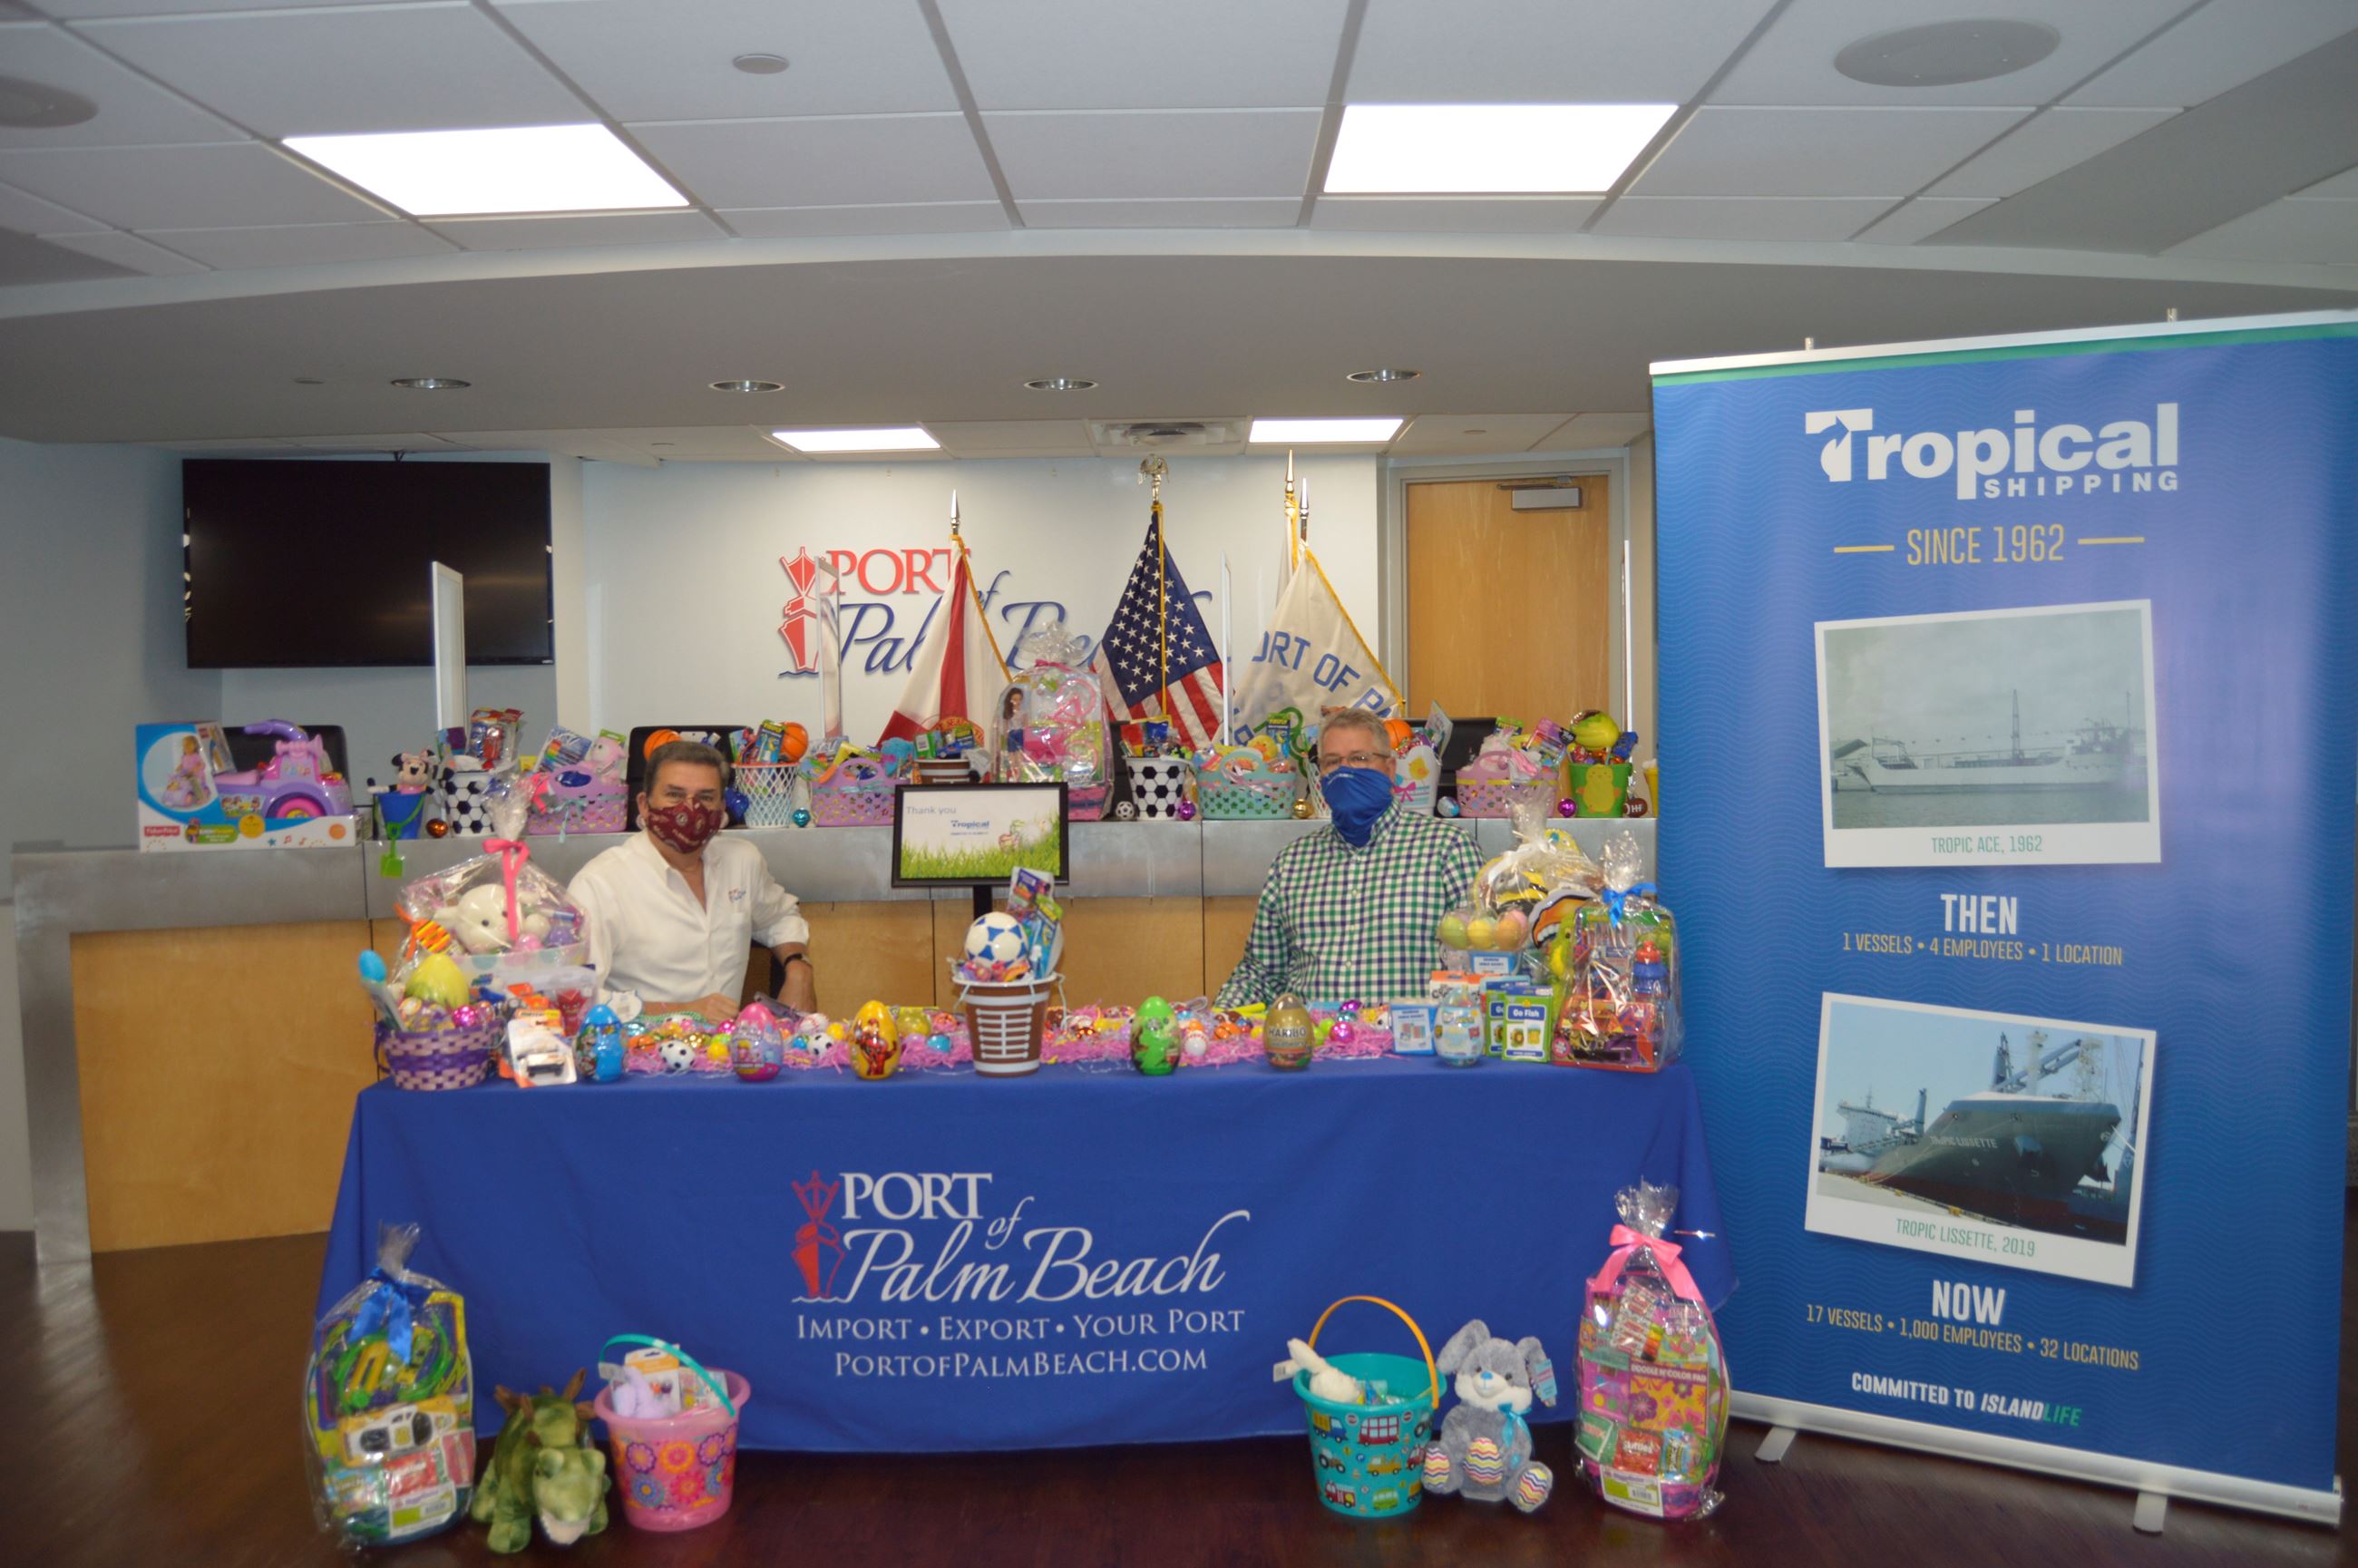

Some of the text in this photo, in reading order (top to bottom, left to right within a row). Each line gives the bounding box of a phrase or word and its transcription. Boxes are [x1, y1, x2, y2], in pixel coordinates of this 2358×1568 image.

[1805, 403, 2178, 500] Tropical
[1983, 471, 2178, 499] SHIPPING
[1906, 523, 2065, 566] SINCE 1962
[826, 594, 944, 675] Pal
[1313, 653, 1360, 693] OF
[906, 806, 957, 815] Thank you
[950, 820, 990, 829] Tropical
[1931, 835, 2043, 854] TROPIC ACE, 1962
[1940, 893, 2018, 935] THEN
[1843, 932, 2123, 966] 1 VESSELS 4 EMPLOYEES 1 LOCATION
[840, 1173, 993, 1219] PORT
[985, 1196, 1035, 1250] of
[1896, 1219, 2036, 1258] TROPIC LISSETTE, 2019
[843, 1210, 1251, 1304] Palm Beach
[1931, 1280, 2006, 1325] NOW
[797, 1309, 1245, 1340] IMPORT EXPORT YOUR PORT
[1807, 1304, 2139, 1370] 17 VESSELS 1,000 EMPLOYEES 32 LOCATIONS
[835, 1349, 1208, 1377] PORTOFPALMBEACH.COM
[1851, 1372, 2083, 1427] COMMITTED TO ISLANDLIFE
